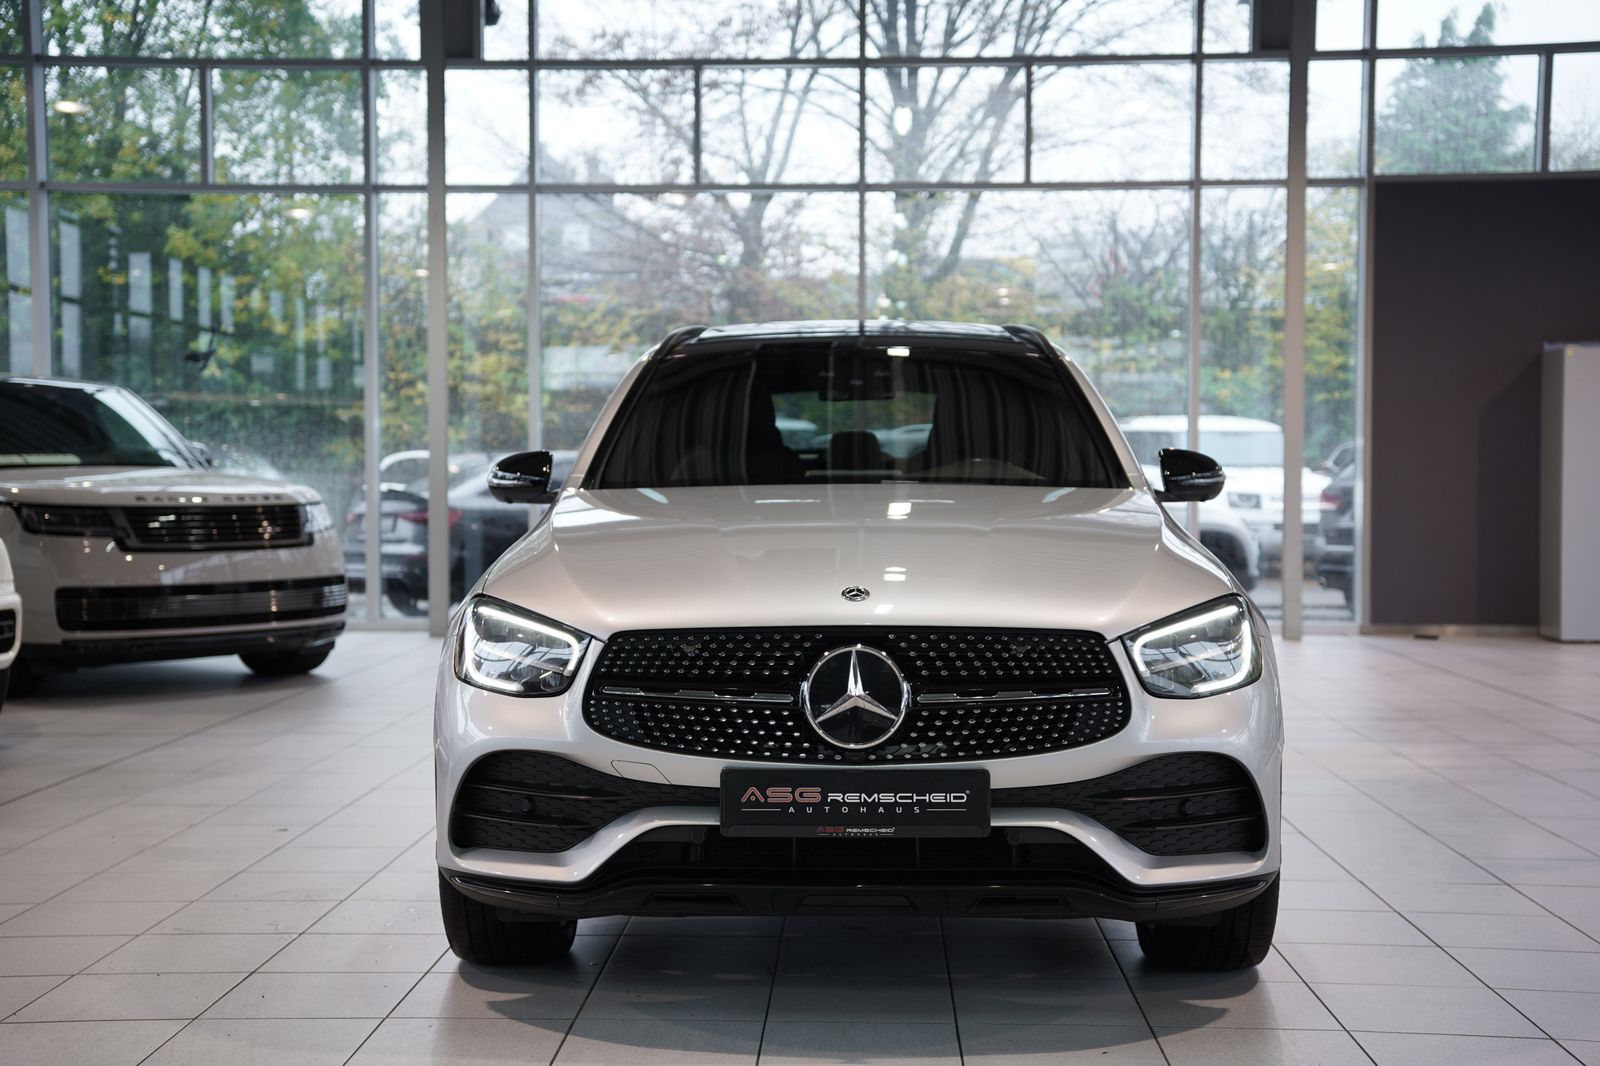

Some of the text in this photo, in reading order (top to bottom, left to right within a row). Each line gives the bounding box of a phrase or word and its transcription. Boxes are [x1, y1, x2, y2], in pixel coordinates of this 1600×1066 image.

[741, 786, 967, 803] ASG REMSCHEID
[788, 806, 920, 814] AUTOHAUS
